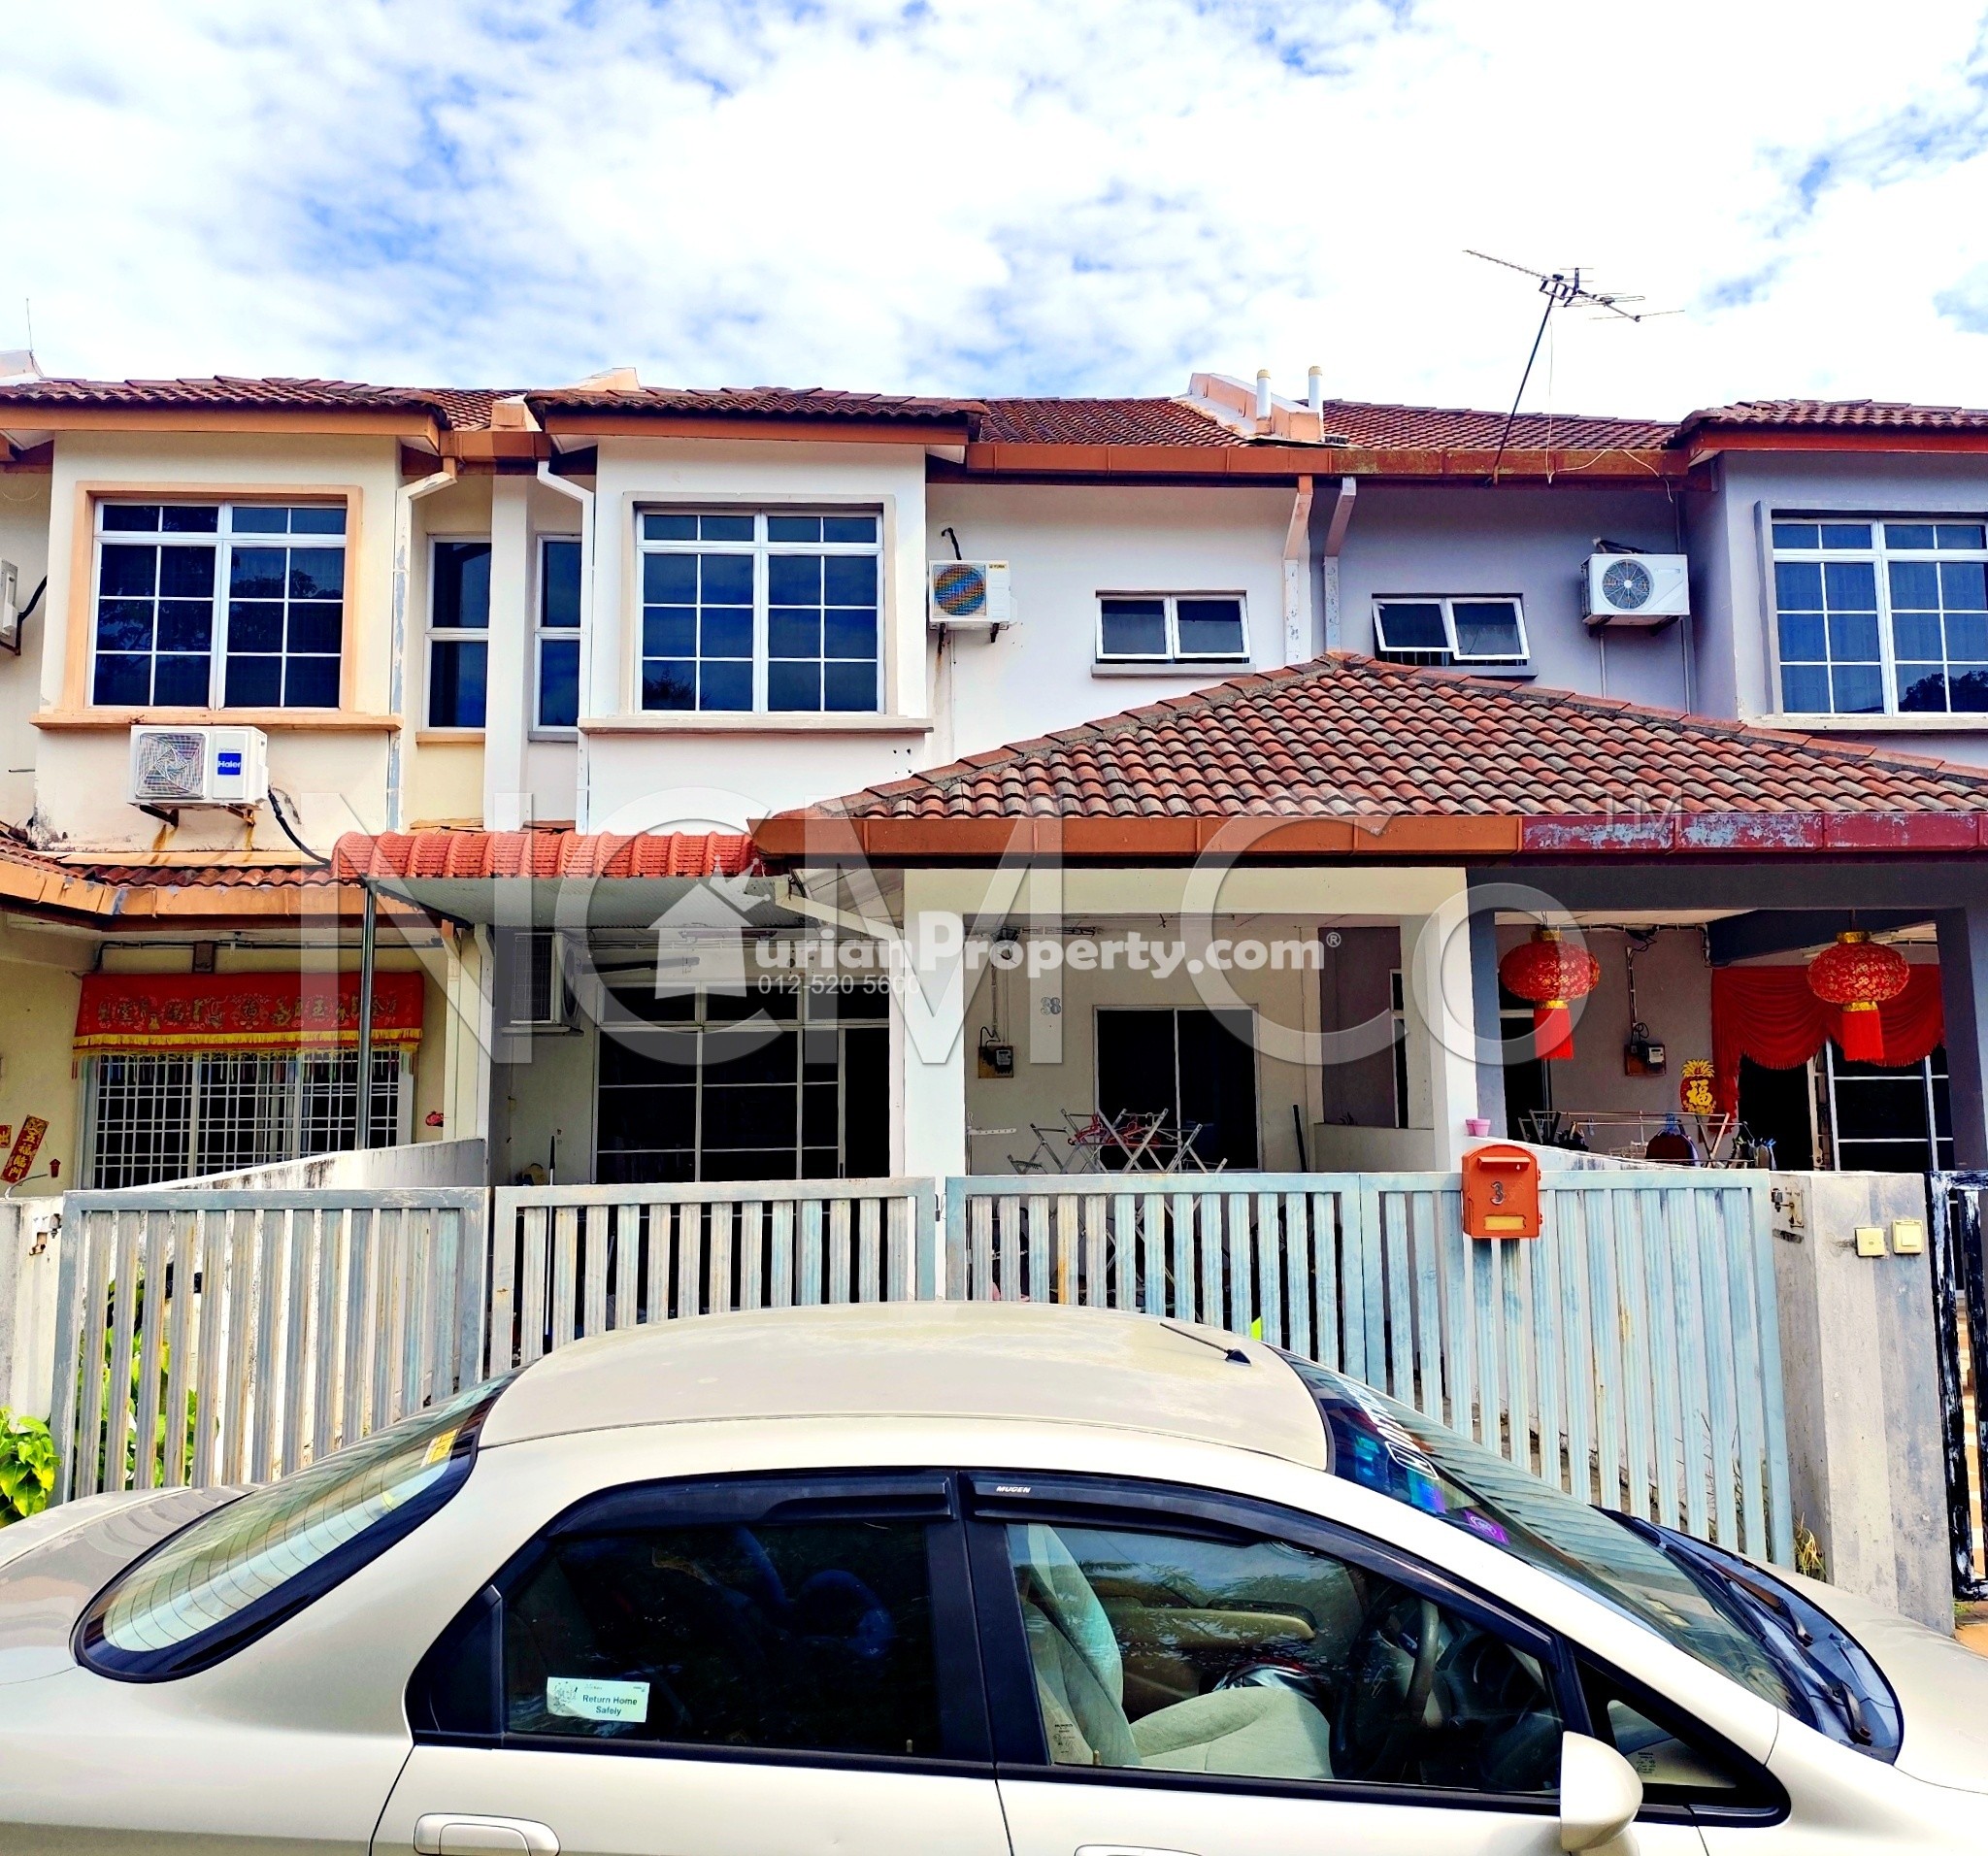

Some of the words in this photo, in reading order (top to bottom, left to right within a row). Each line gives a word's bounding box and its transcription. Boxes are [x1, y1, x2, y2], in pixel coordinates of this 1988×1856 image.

[1686, 1078, 1712, 1106] 福
[1490, 1179, 1505, 1206] 3
[582, 1694, 611, 1704] Return
[613, 1696, 638, 1706] Home
[595, 1706, 622, 1716] Safely
